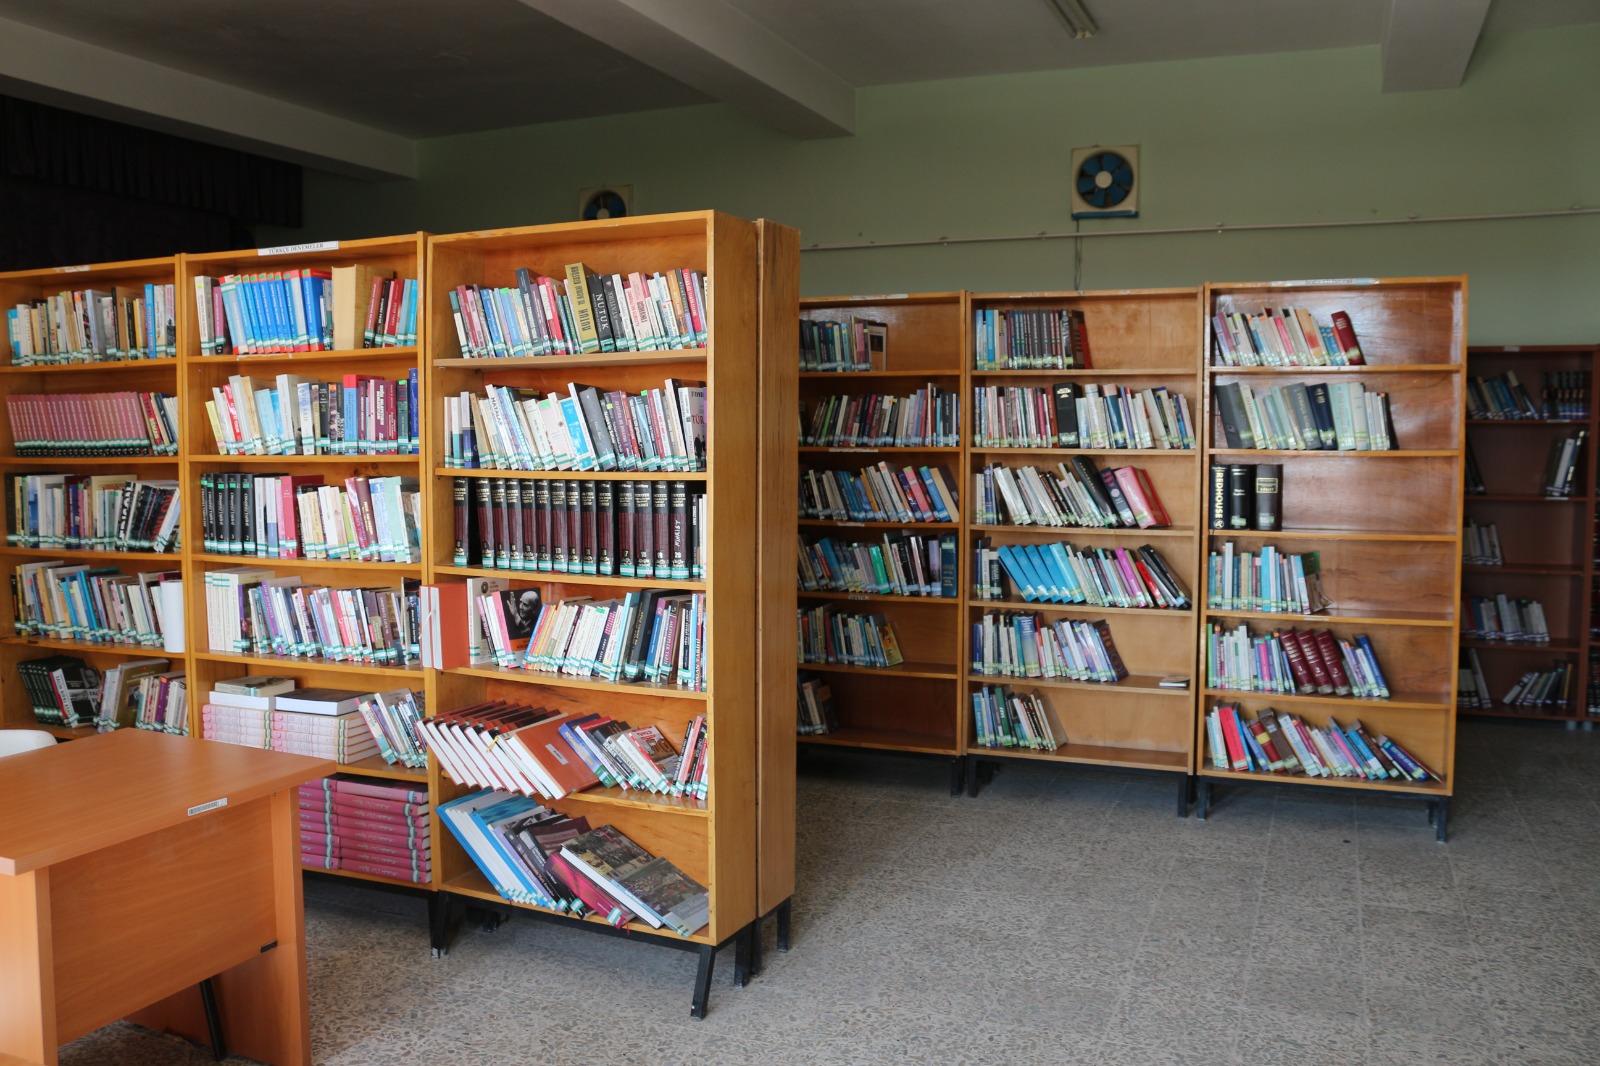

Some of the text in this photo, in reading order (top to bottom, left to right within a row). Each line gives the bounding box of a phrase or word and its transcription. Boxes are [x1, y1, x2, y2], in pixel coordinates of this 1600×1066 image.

[291, 243, 324, 252] DENEMELER
[595, 293, 608, 330] NUTUK
[1215, 472, 1224, 519] REDHOUSE
